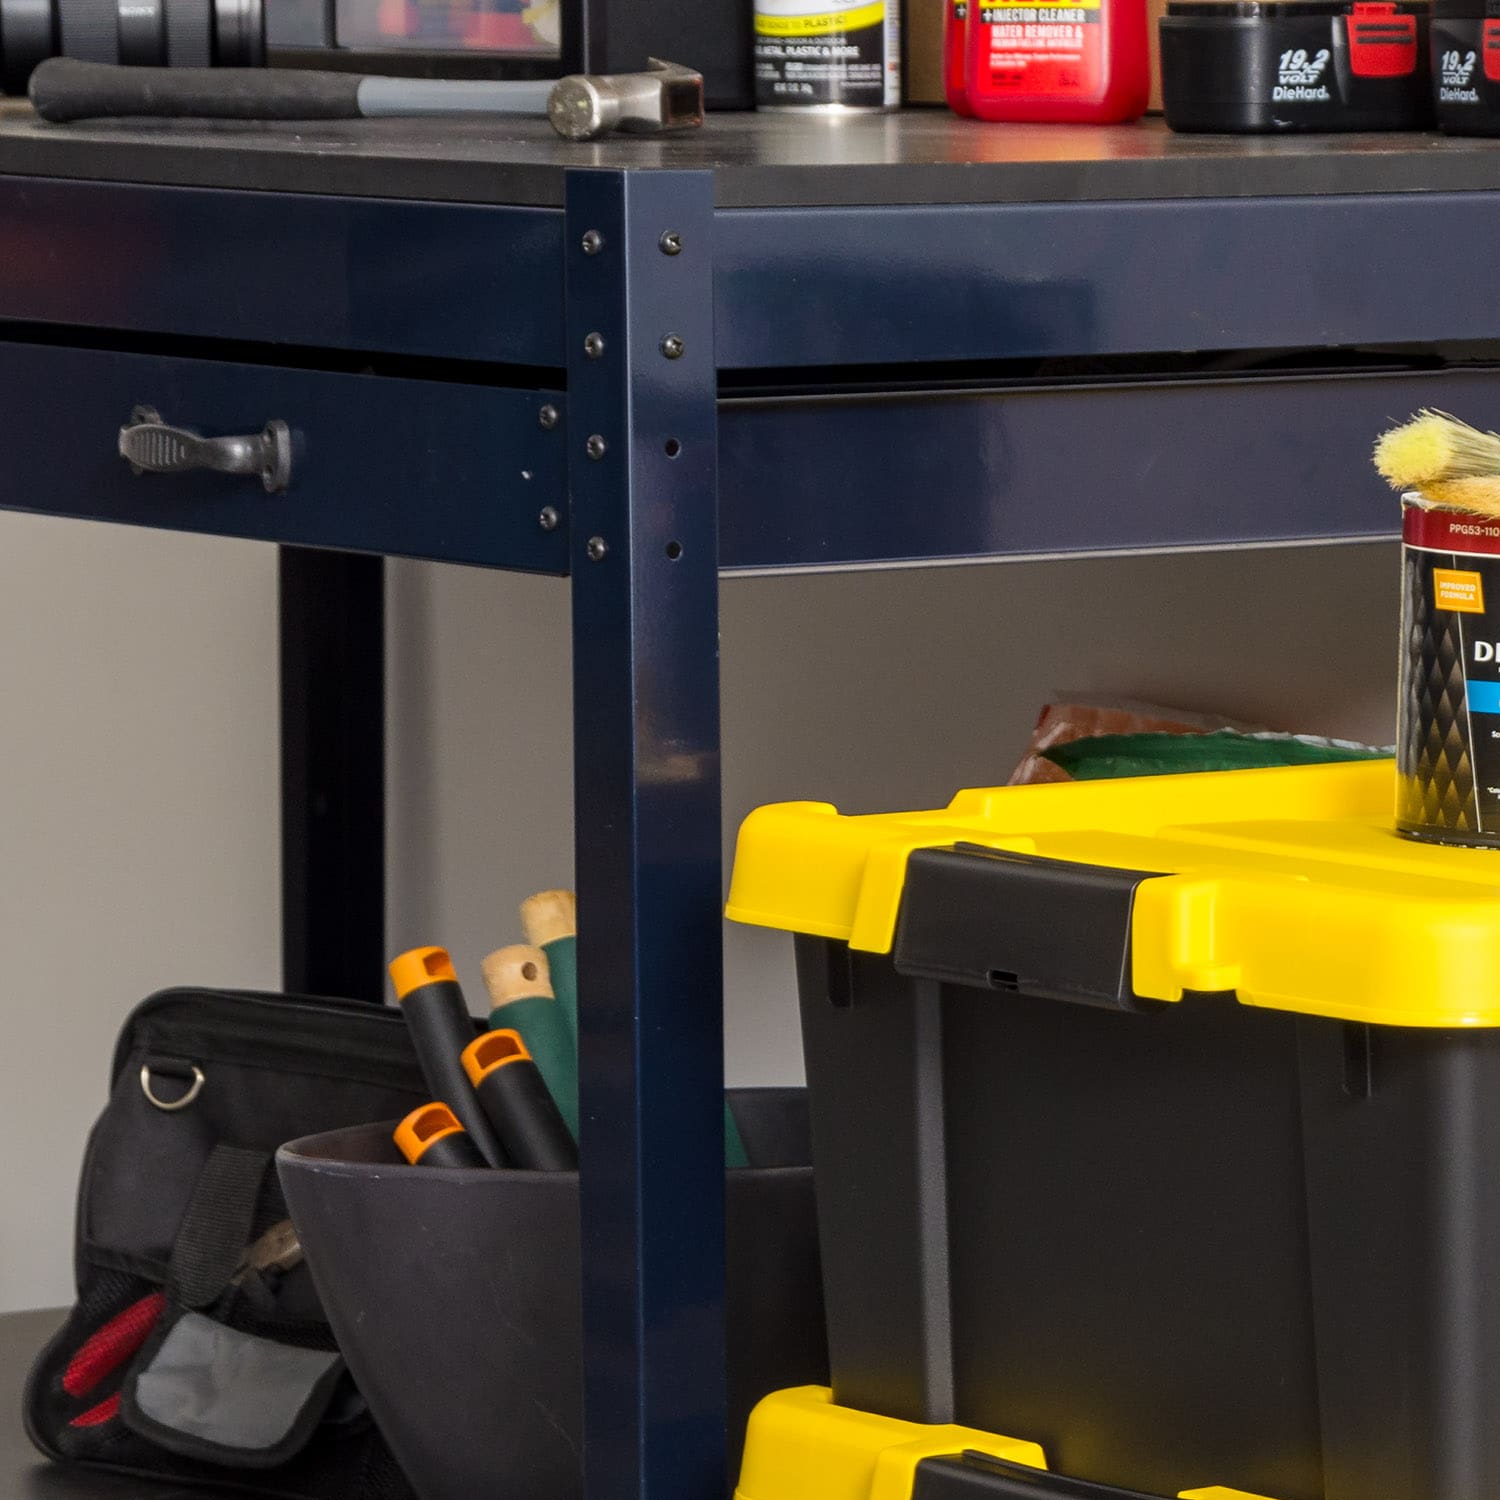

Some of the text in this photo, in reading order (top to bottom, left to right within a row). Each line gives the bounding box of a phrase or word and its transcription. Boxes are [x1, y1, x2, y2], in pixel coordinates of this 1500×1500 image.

[1038, 8, 1085, 22] CLEANER
[991, 25, 1023, 37] WATER
[1025, 25, 1073, 37] REMOVER
[831, 46, 860, 57] MORE
[1279, 49, 1330, 70] 19.2
[1441, 50, 1476, 71] 19.2
[1278, 75, 1319, 84] VOLT
[1442, 76, 1469, 85] VOLT
[1273, 86, 1326, 100] DieHard
[1440, 87, 1476, 101] DieHard
[1449, 524, 1500, 538] PPG53-110
[1440, 590, 1474, 600] FORMULA
